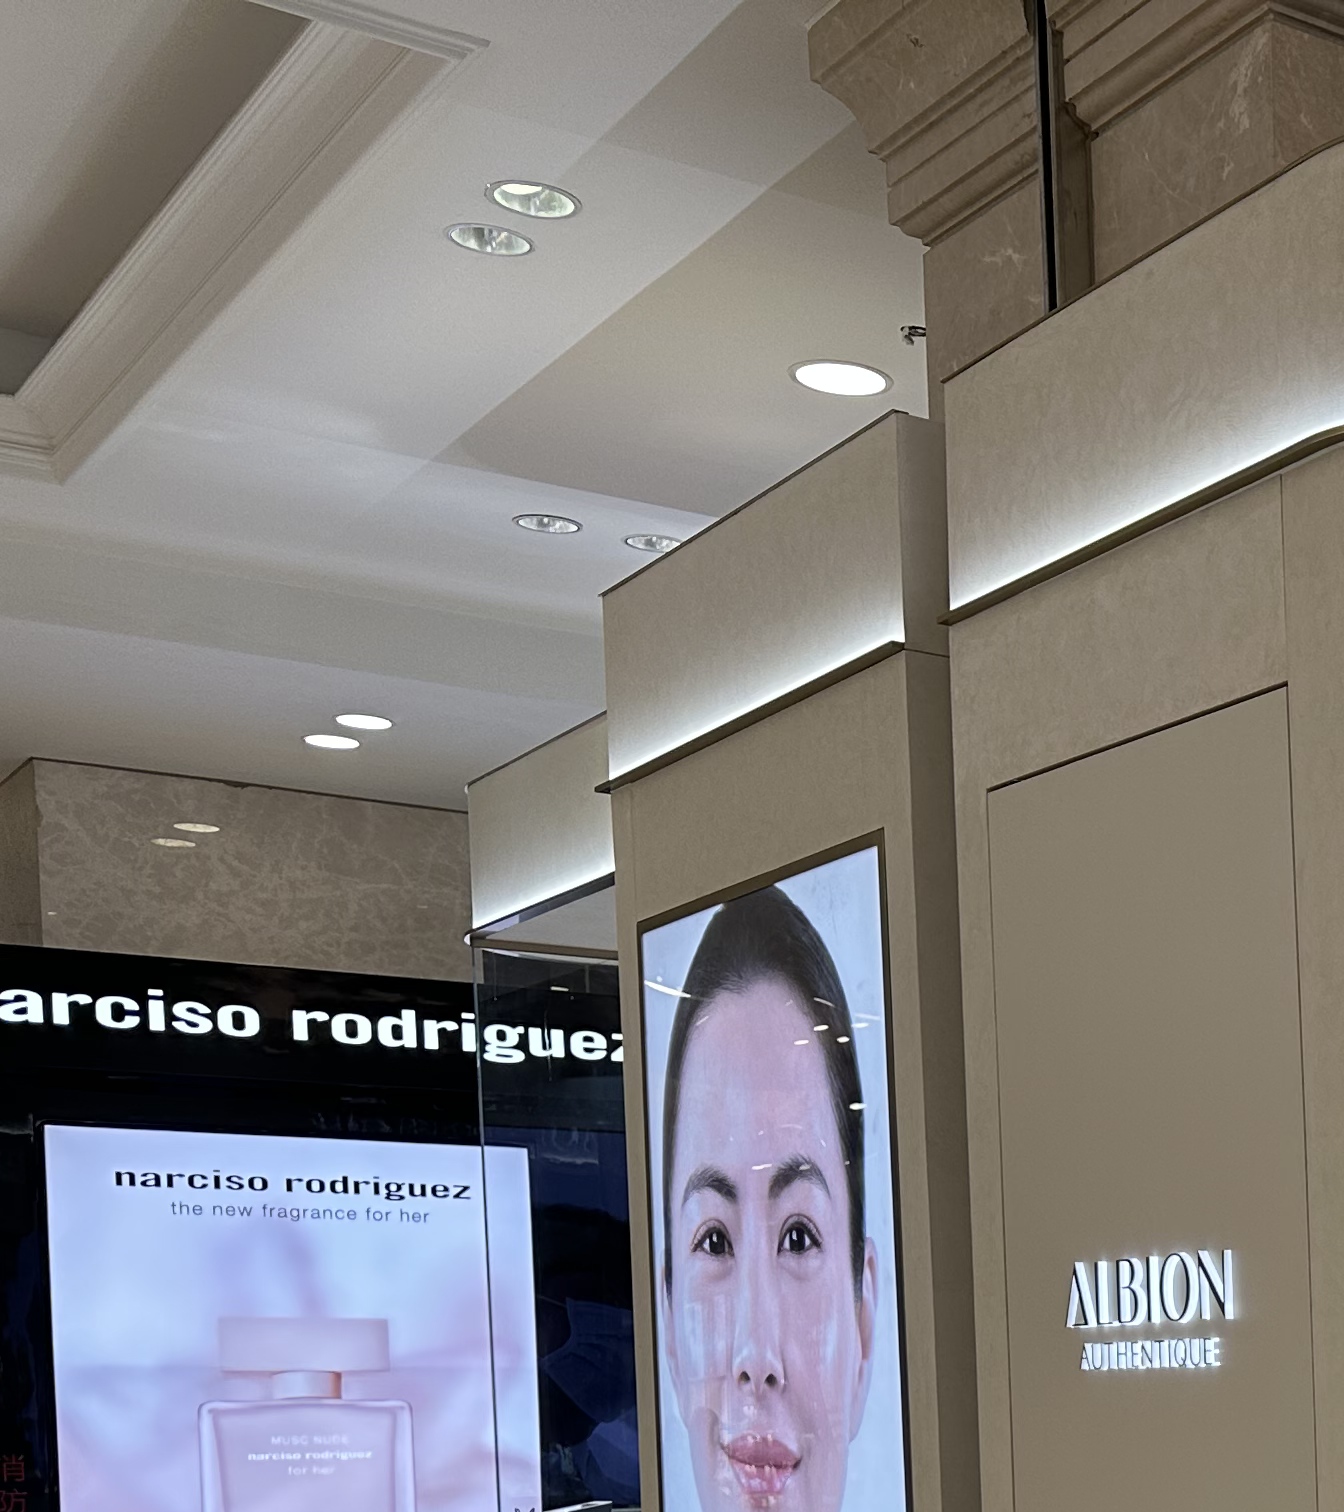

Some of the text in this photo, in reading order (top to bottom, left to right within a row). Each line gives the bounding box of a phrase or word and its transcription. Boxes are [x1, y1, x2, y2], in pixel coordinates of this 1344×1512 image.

[0, 988, 260, 1037] arciso
[115, 1169, 472, 1201] narciso rodriguez
[171, 1201, 430, 1224] the new fragrance for her
[1065, 1249, 1235, 1328] ALBION
[1080, 1337, 1222, 1370] AUTHENTIQUE
[248, 1451, 301, 1461] narciso
